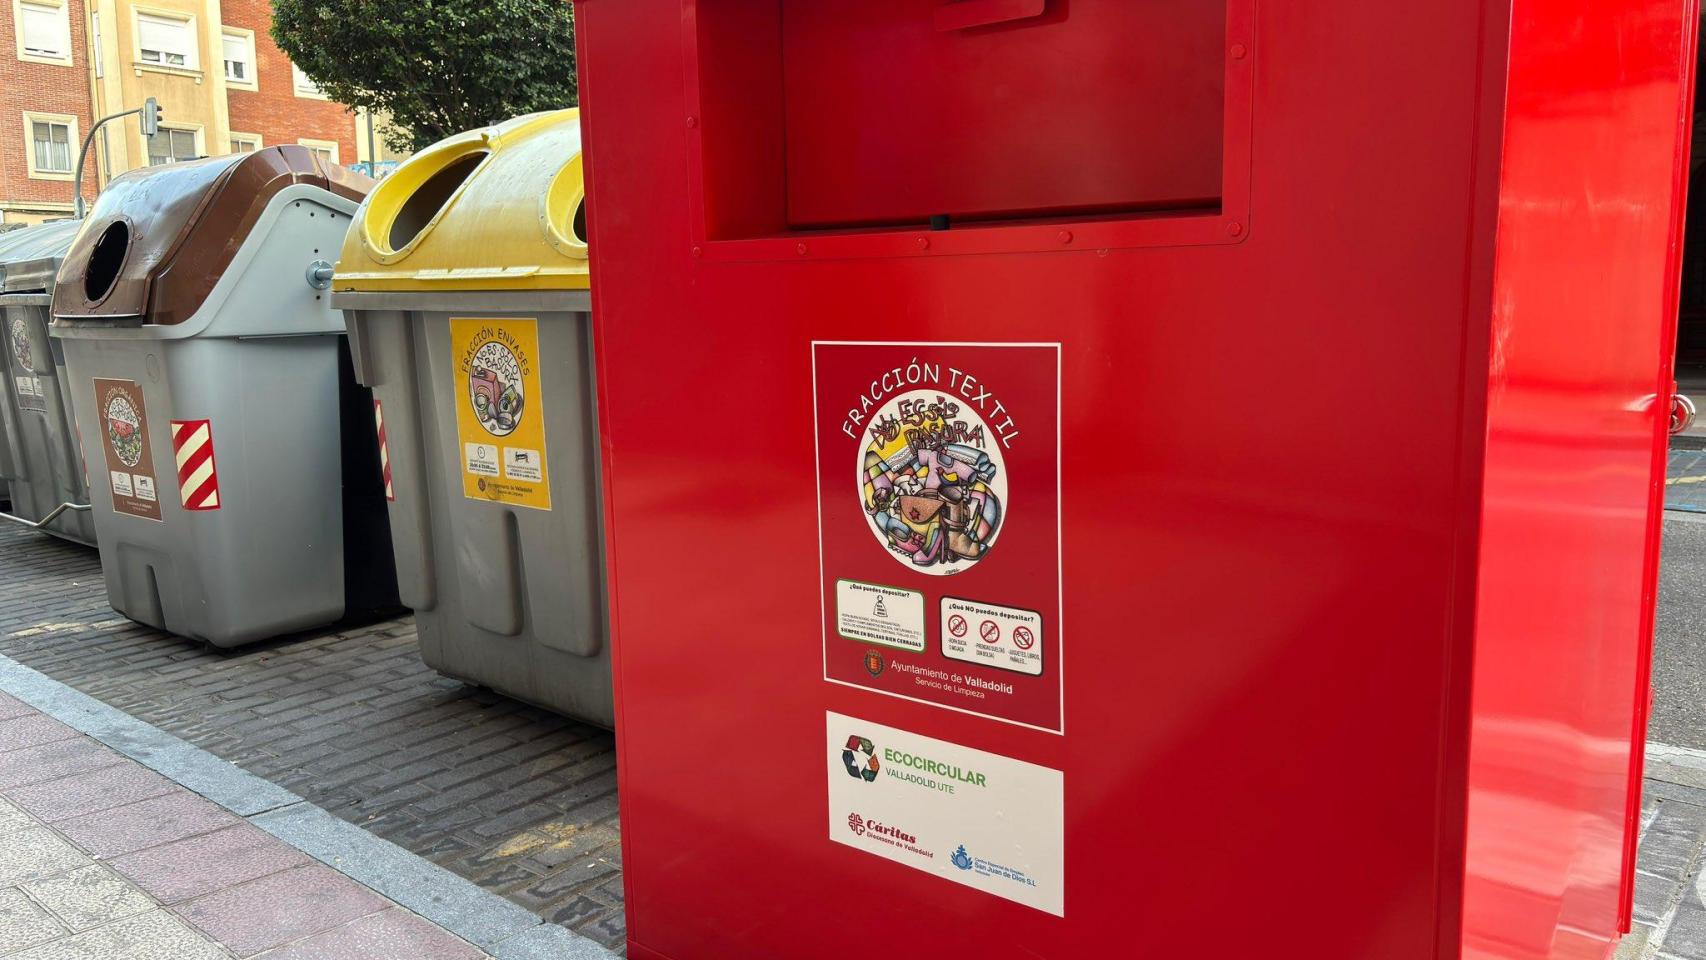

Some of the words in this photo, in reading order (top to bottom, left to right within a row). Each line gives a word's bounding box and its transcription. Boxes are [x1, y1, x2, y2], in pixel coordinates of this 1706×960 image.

[462, 326, 493, 374] FRACCIÓN
[498, 328, 530, 376] ENVASES
[842, 357, 939, 439] FRACCIÓN
[949, 367, 1019, 449] TEXTIL
[897, 399, 925, 426] ES
[882, 588, 910, 598] depositar?
[949, 603, 964, 611] ¿Qué
[975, 608, 998, 616] puedes
[999, 611, 1034, 622] depositar?
[891, 660, 948, 680] Ayuntamiento
[950, 673, 962, 684] de
[964, 675, 1013, 694] Valladolid
[915, 677, 942, 689] Servicio
[943, 682, 952, 691] de
[953, 685, 985, 699] Limpieza
[884, 748, 986, 787] ECOCIRCULAR
[885, 767, 936, 789] VALLADOLID
[937, 782, 954, 794] UTE
[866, 819, 916, 844] Cáritas
[904, 843, 934, 858] Valladolid
[974, 861, 987, 871] San
[987, 866, 1002, 876] Juan
[1011, 873, 1026, 883] Dios
